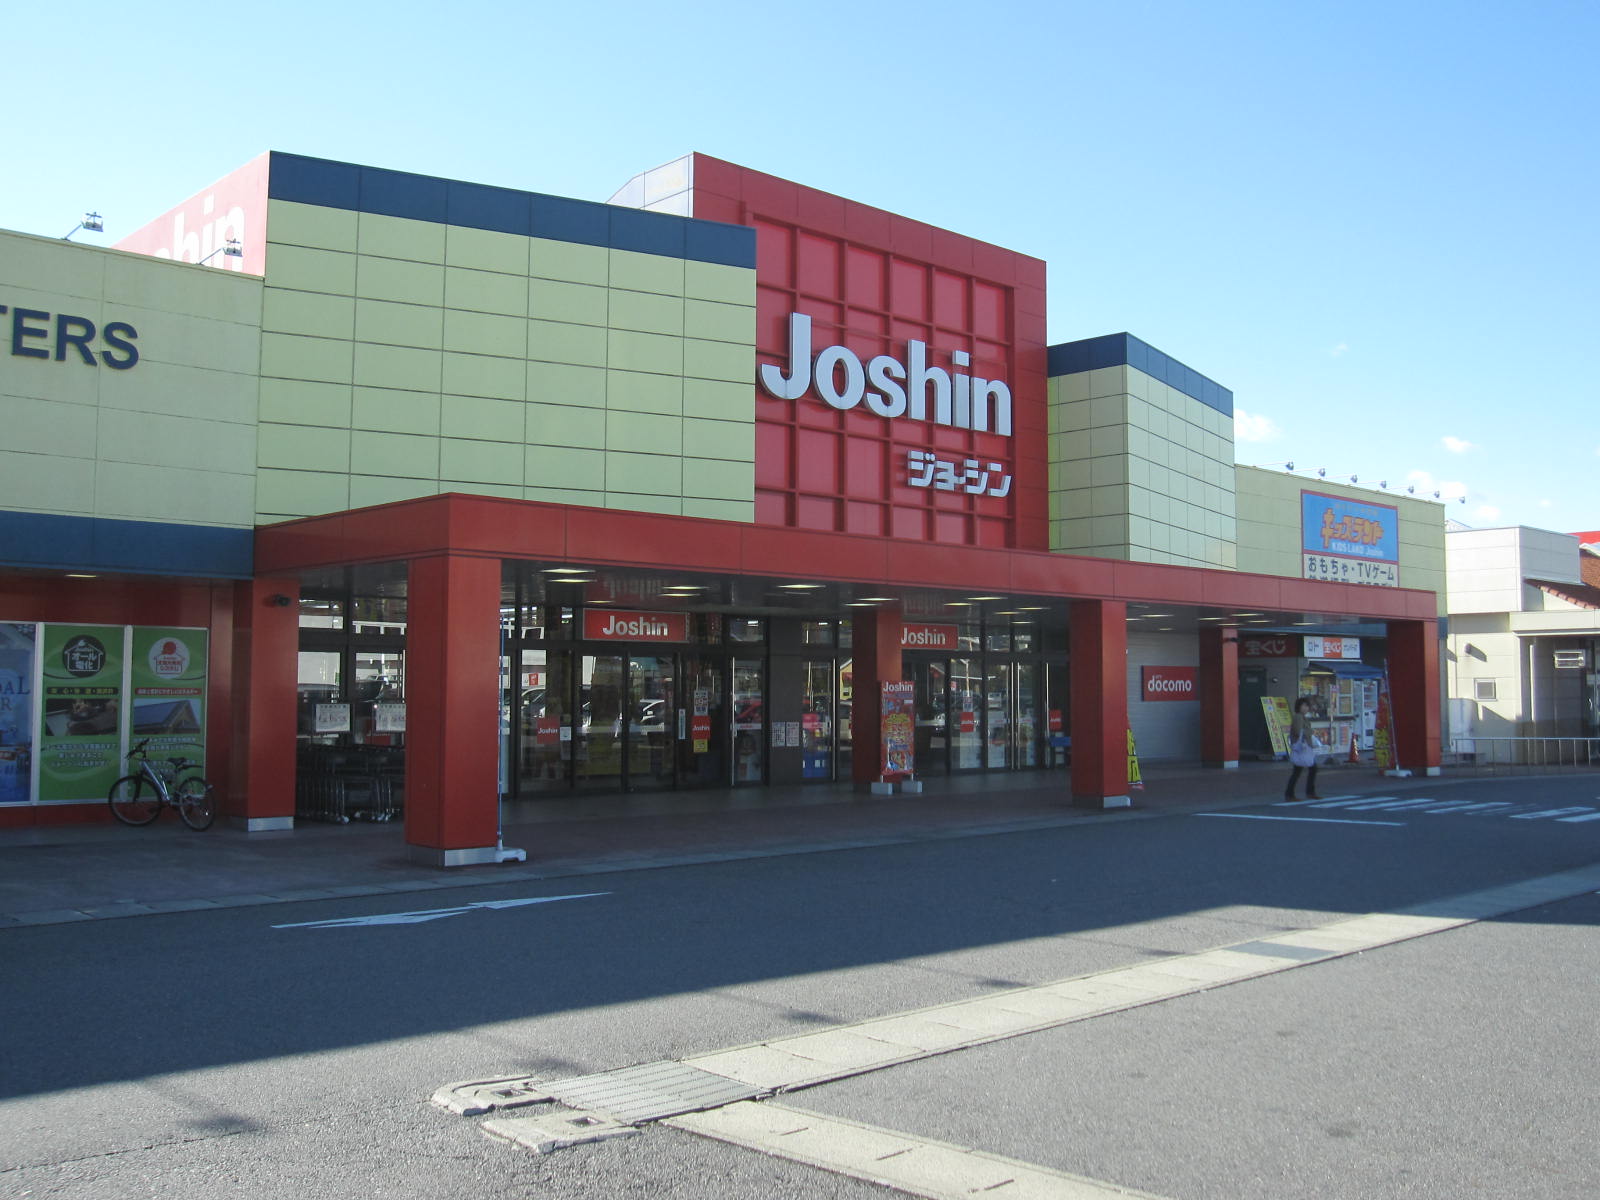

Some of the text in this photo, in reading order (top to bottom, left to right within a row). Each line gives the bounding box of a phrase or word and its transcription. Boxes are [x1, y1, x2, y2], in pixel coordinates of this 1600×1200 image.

[0, 304, 139, 370] ERS
[759, 311, 1012, 437] Joshin
[908, 450, 1012, 498] ジョーシン
[1308, 555, 1395, 581] おもちゃ・TVゲーム
[602, 615, 668, 636] Joshin
[901, 627, 946, 645] Joshin
[0, 676, 31, 695] AL
[883, 680, 914, 692] Joshin
[1147, 674, 1192, 692] docomo
